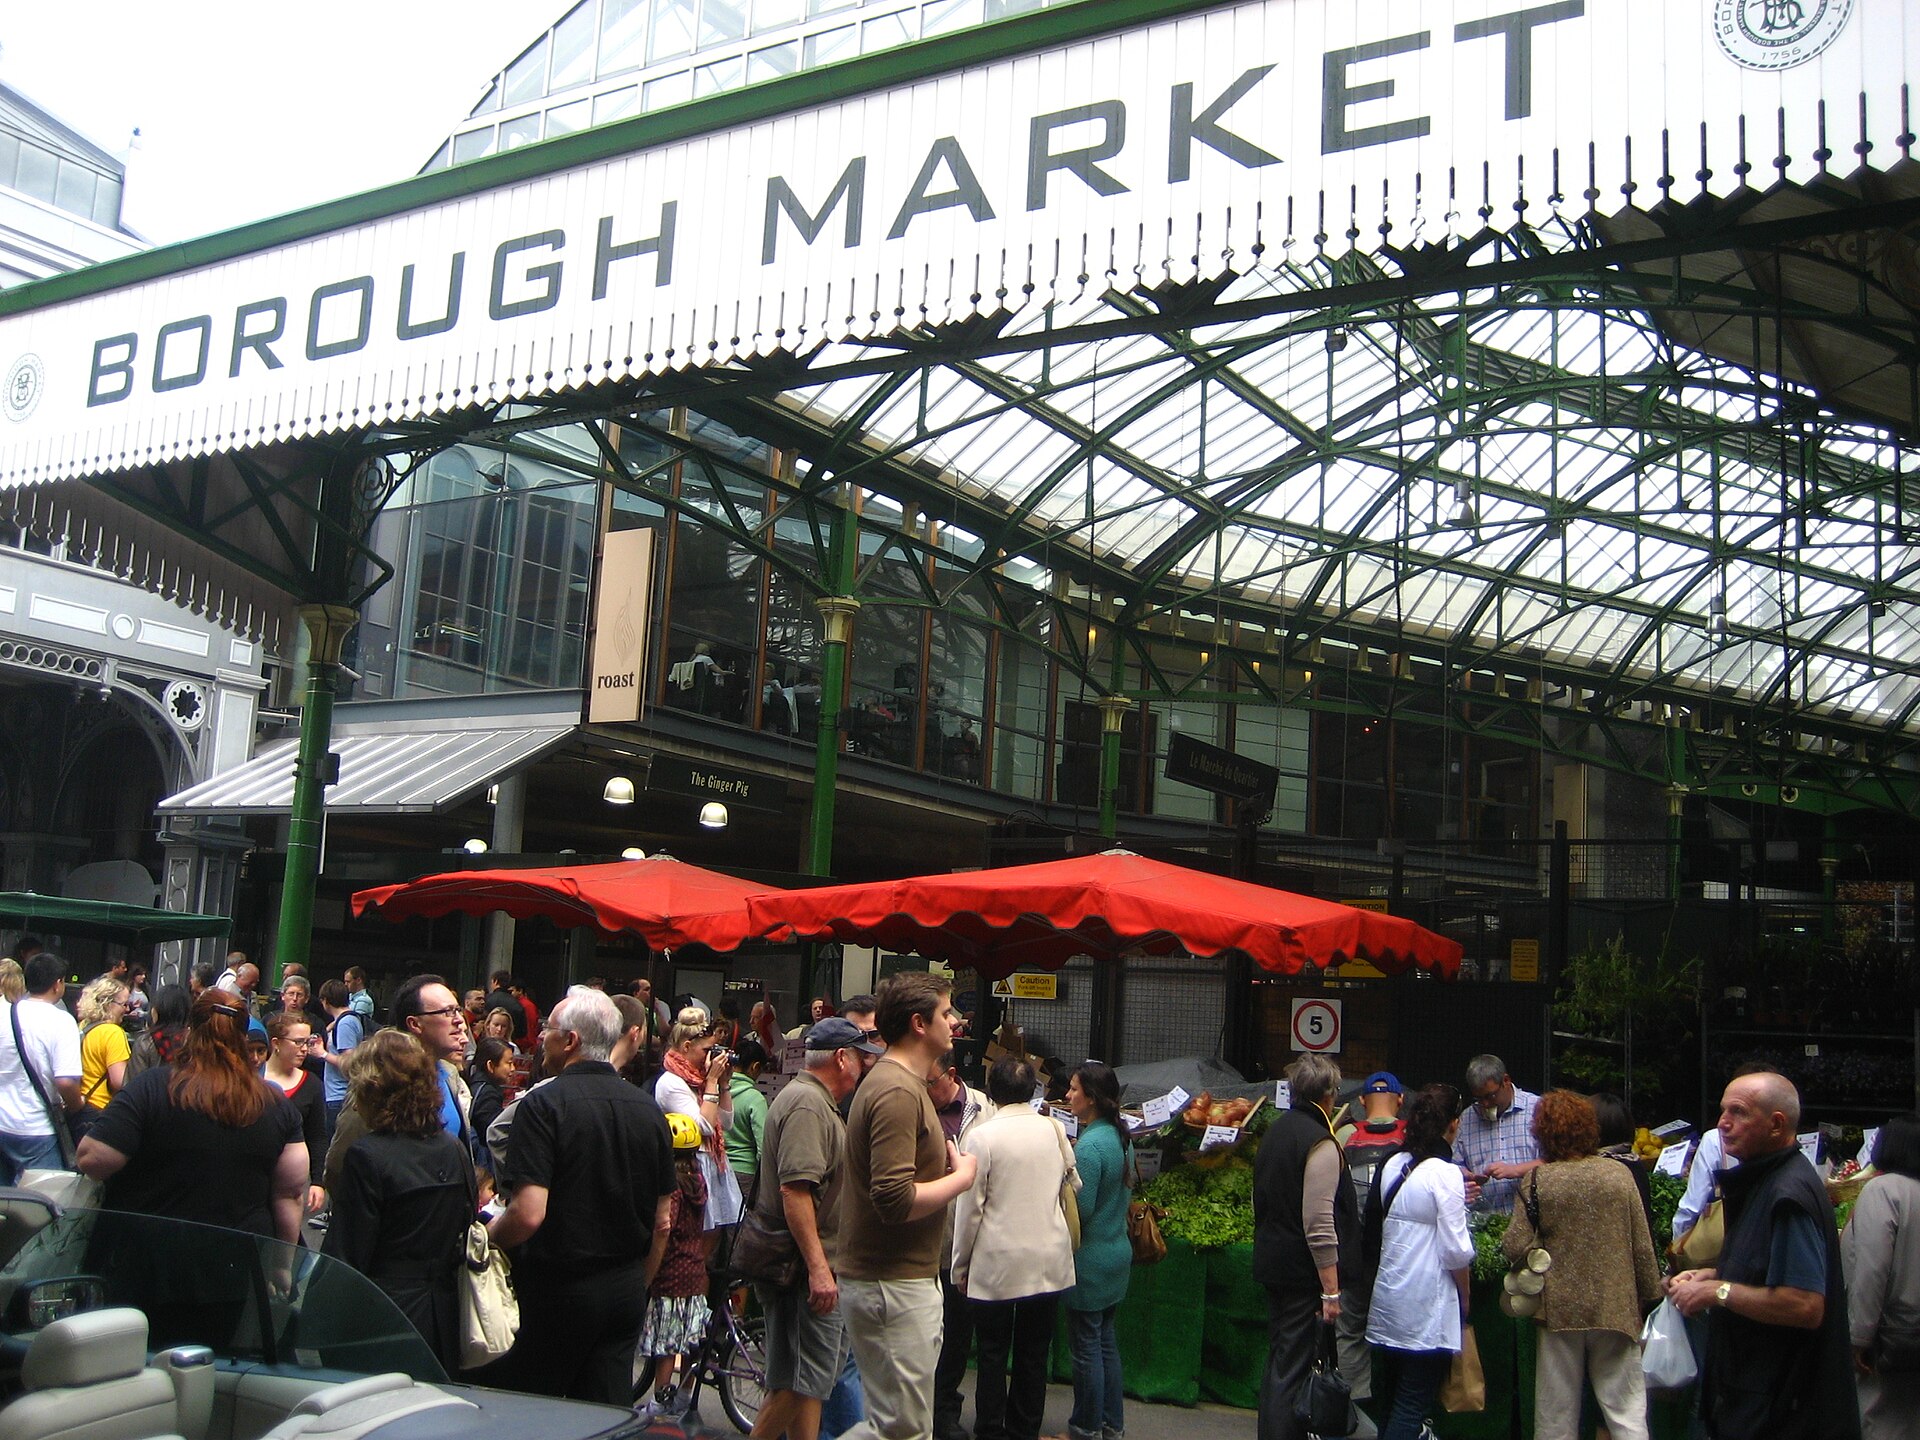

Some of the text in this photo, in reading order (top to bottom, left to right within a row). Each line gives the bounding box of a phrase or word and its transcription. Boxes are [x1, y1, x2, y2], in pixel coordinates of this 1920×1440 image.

[1762, 46, 1801, 61] 1756
[87, 0, 1585, 408] BOROUGH MARKET
[598, 671, 635, 689] roast
[691, 771, 750, 797] The Ginger Pig
[1020, 976, 1050, 985] Caution
[1310, 1015, 1322, 1035] 5
